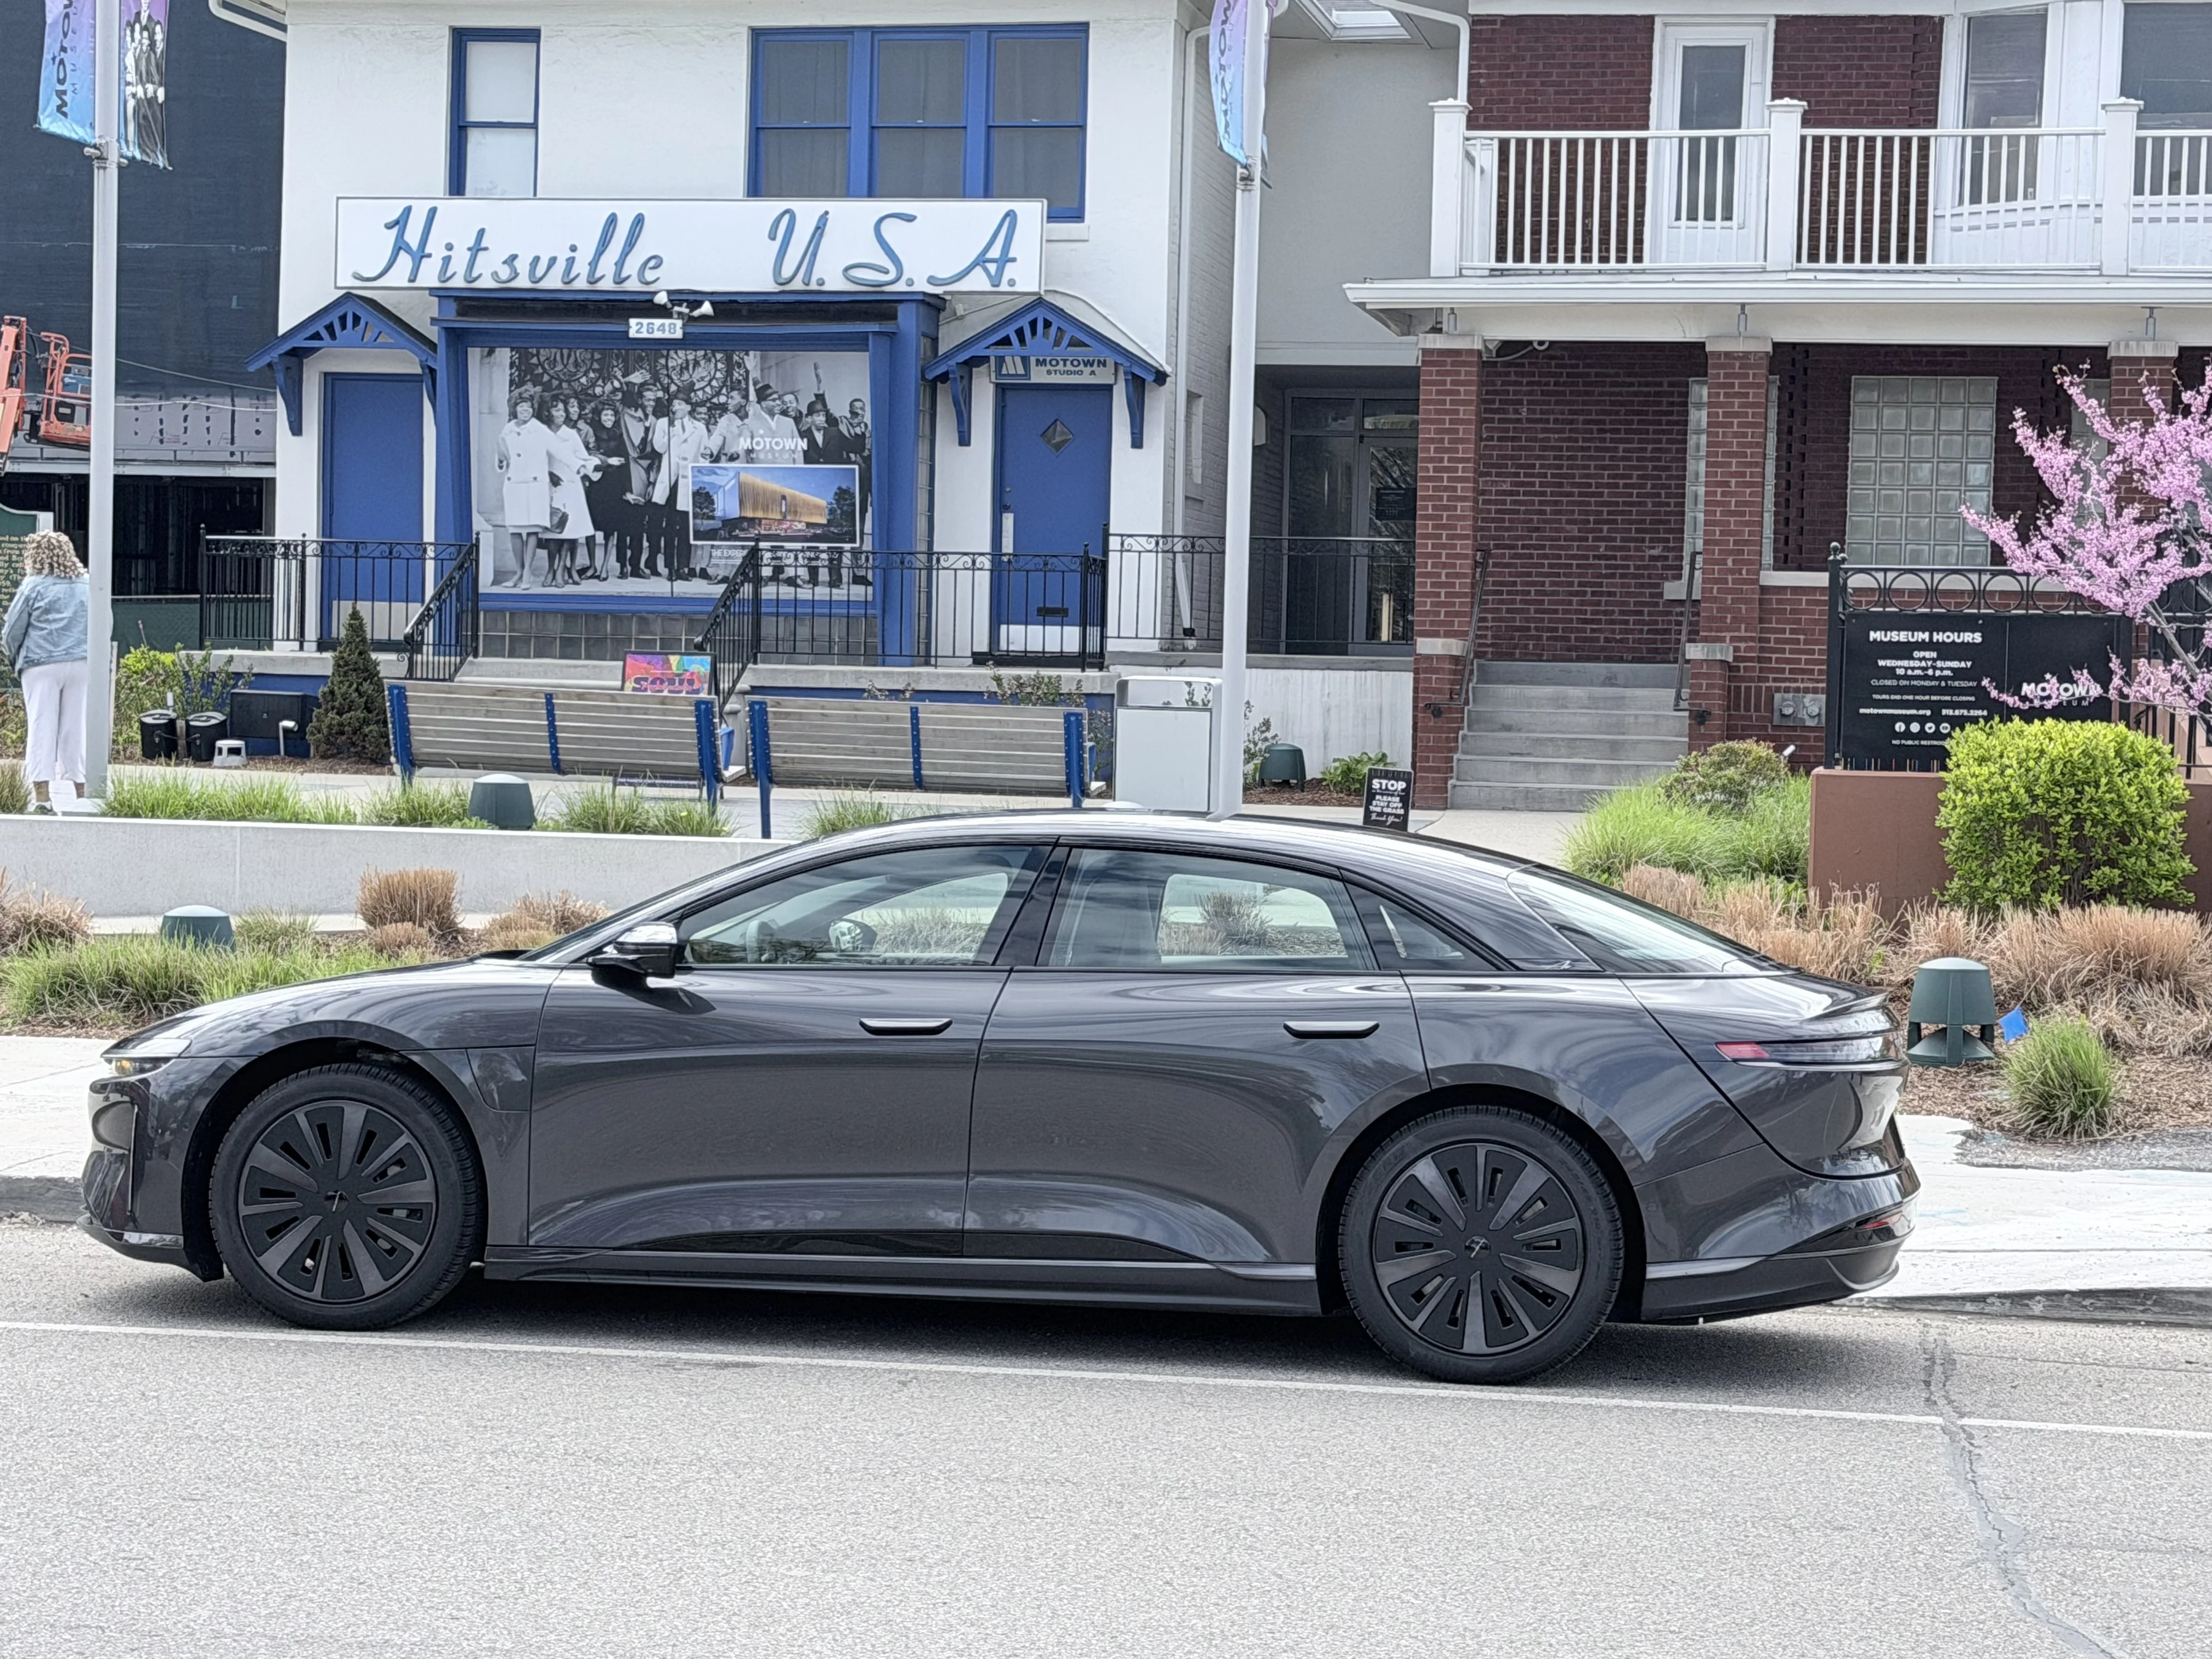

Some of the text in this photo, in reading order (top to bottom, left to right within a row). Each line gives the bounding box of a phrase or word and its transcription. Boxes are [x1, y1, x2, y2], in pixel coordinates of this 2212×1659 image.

[352, 205, 663, 285] Hitsville
[635, 321, 678, 335] 2648
[1035, 358, 1107, 368] MOTOWN
[739, 437, 808, 450] MOTOWN
[1869, 631, 1983, 644] MUSEUM HOURS
[631, 676, 701, 695] SOUL
[1372, 778, 1407, 791] STOP
